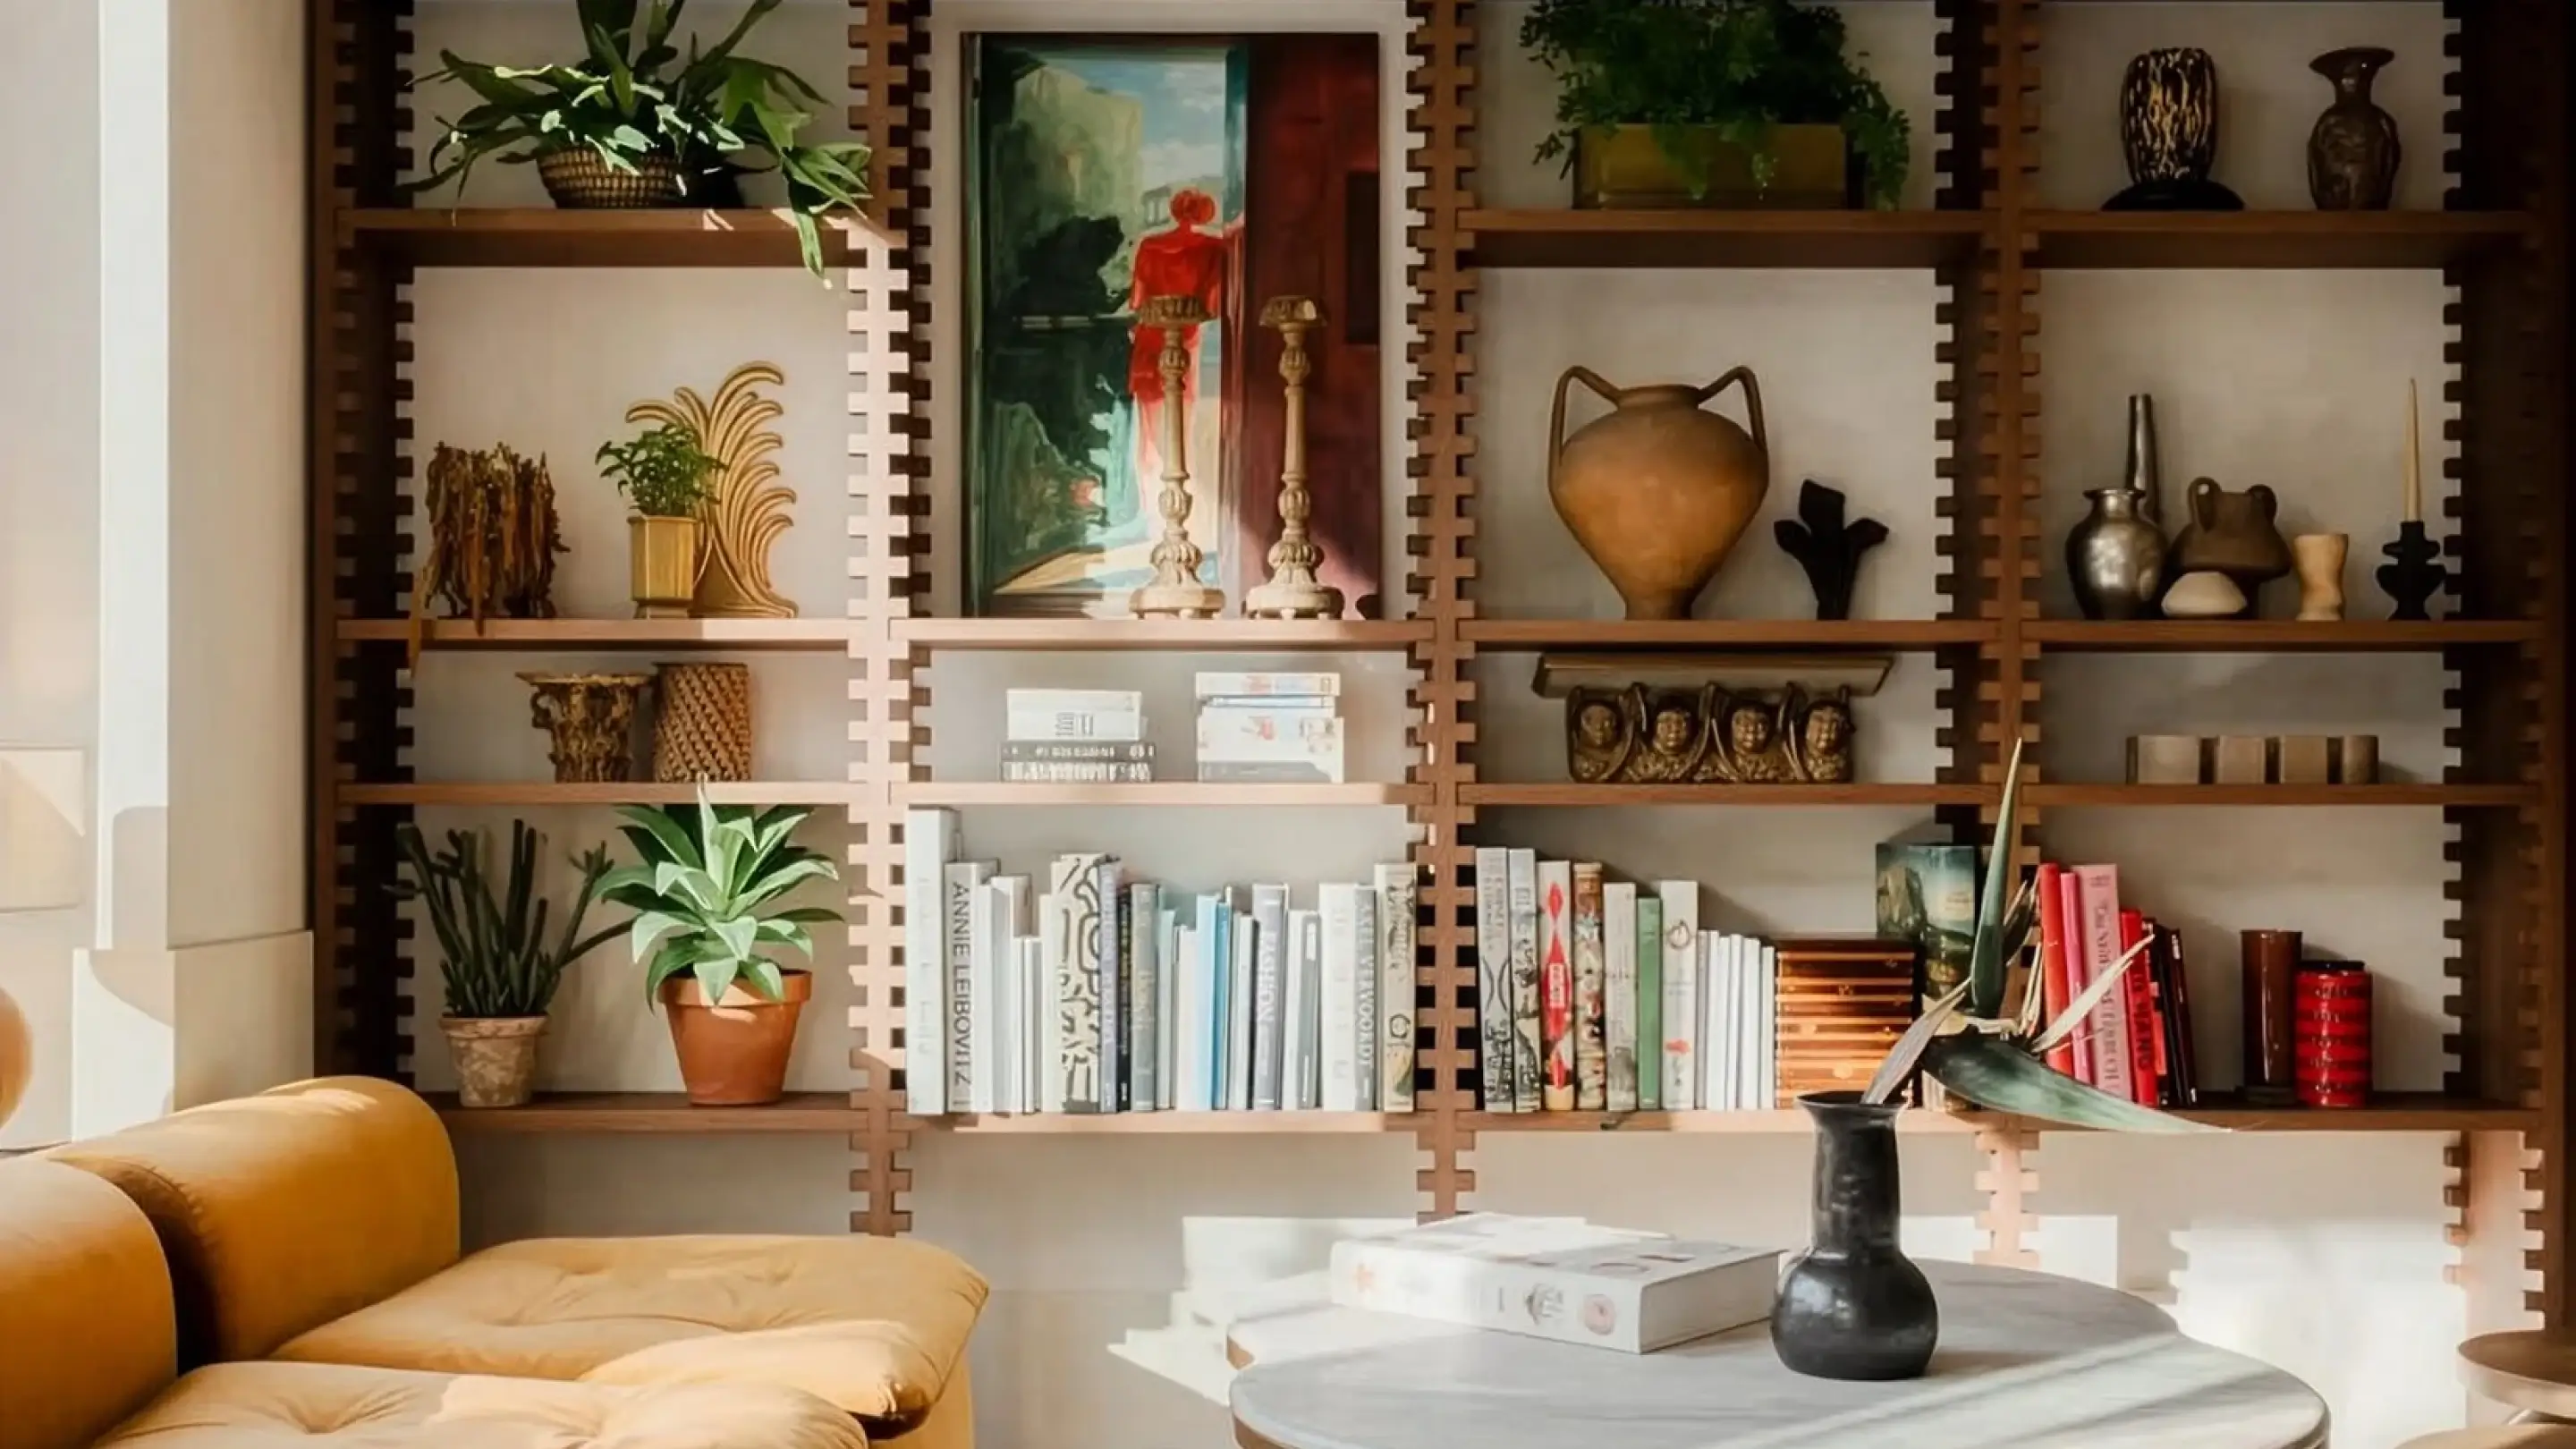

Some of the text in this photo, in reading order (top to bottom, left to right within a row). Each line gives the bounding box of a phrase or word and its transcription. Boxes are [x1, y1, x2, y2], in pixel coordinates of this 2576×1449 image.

[953, 881, 972, 1086] ANNIE LEIBOVITZ
[1358, 955, 1375, 1069] VERVOORDT
